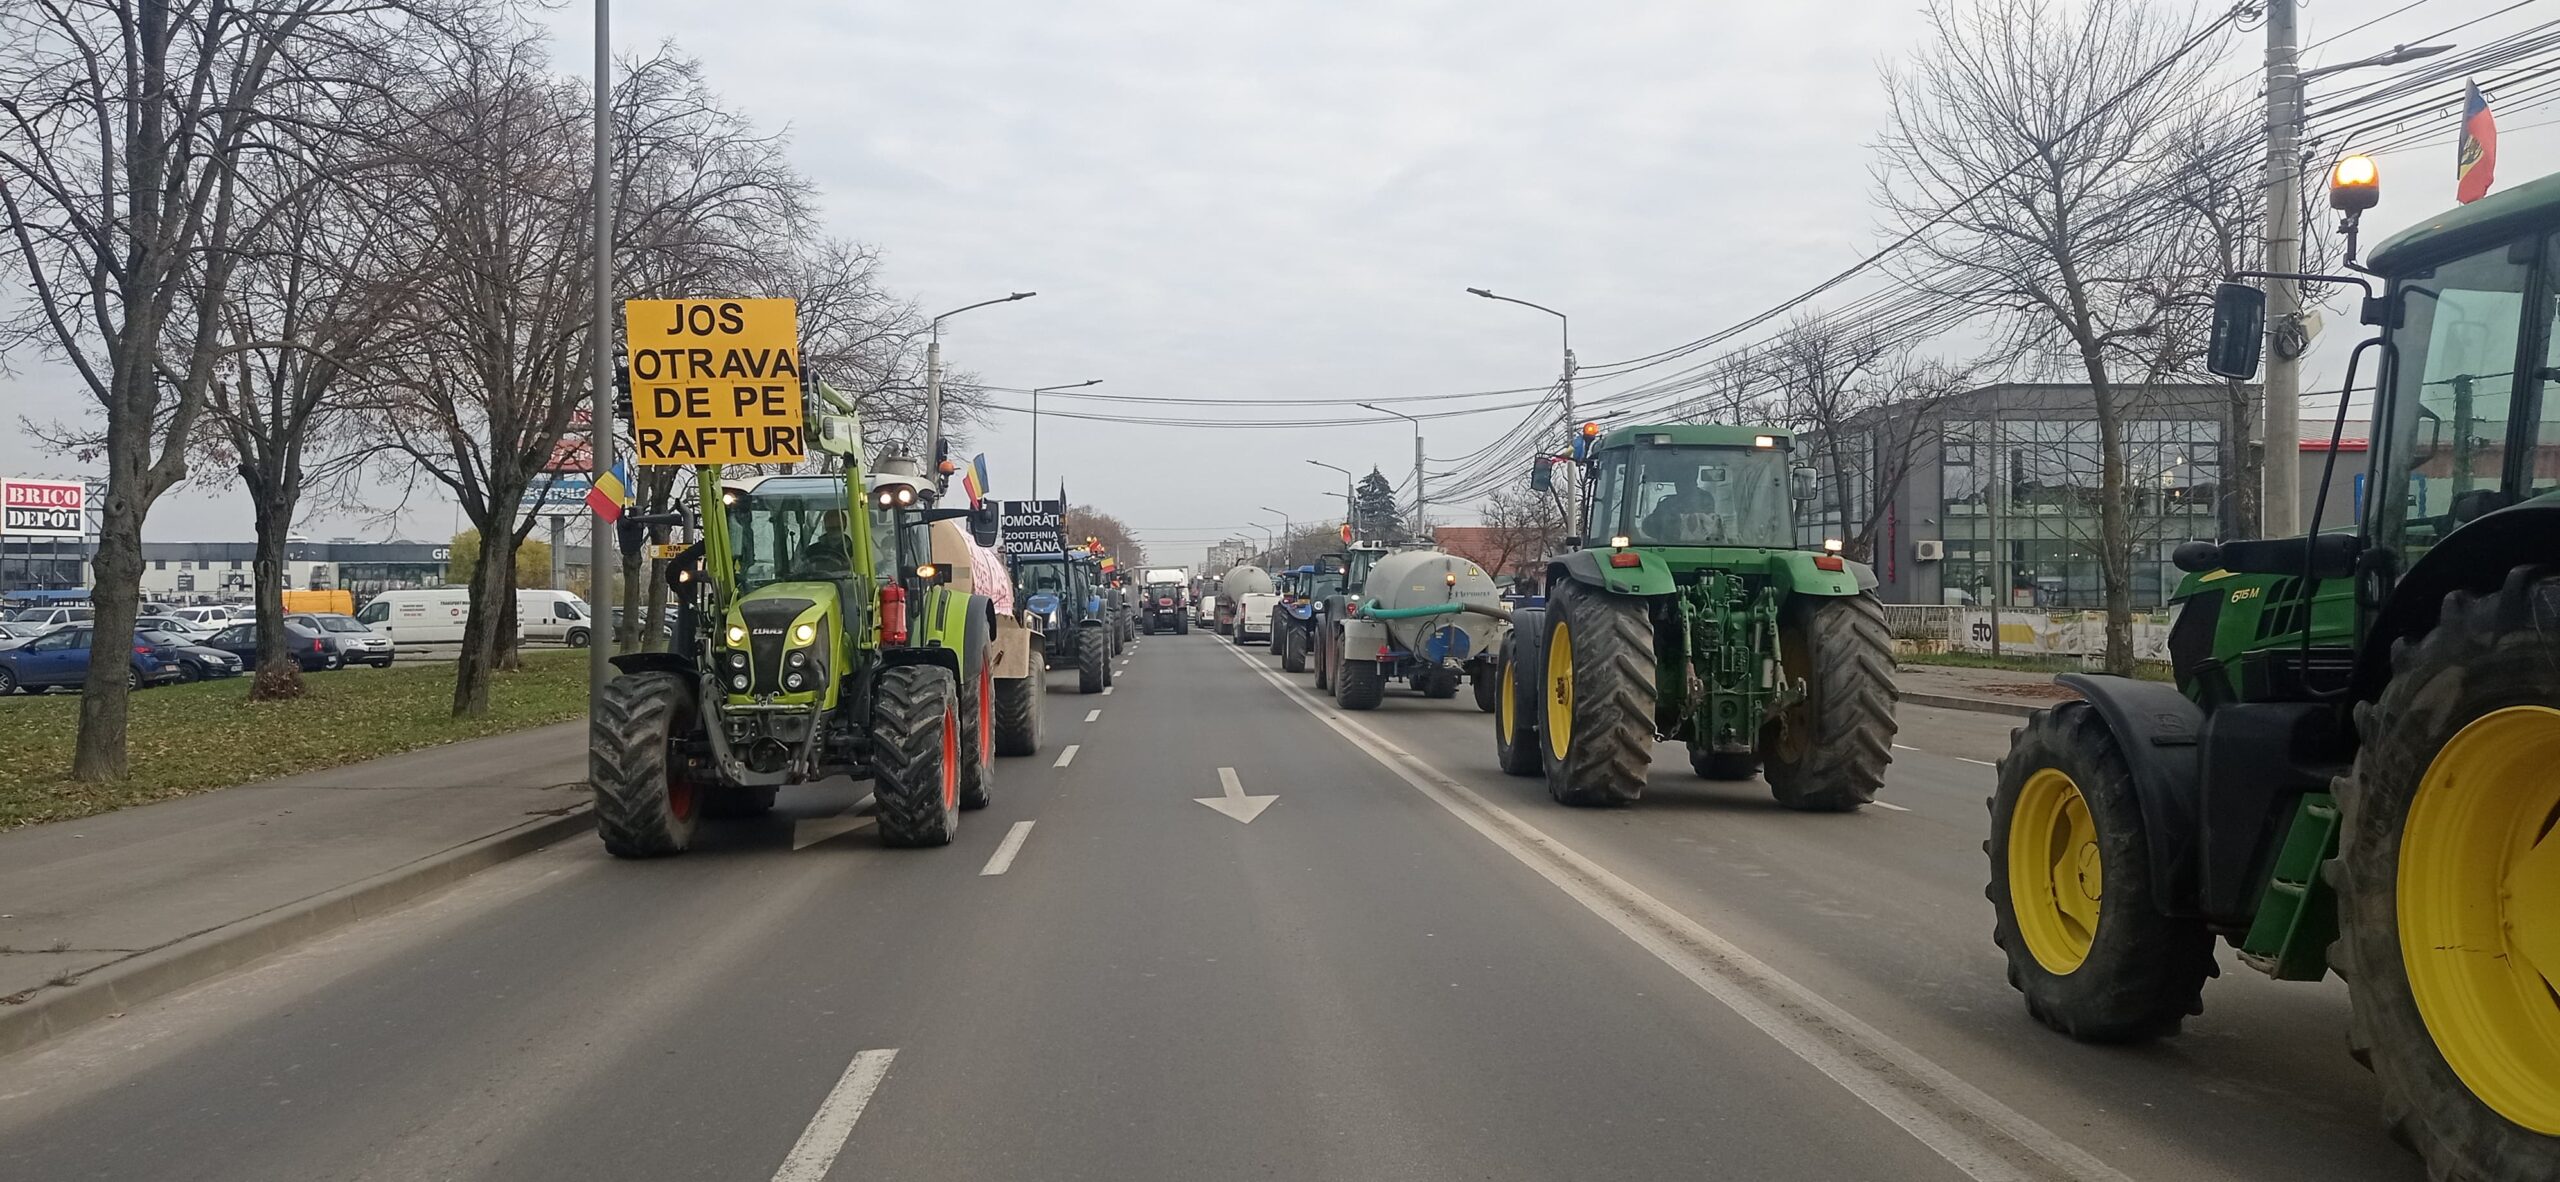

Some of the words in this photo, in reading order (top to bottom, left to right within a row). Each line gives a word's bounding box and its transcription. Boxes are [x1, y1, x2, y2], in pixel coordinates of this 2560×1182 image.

[667, 303, 744, 336] JOS
[634, 348, 798, 380] OTRAVA
[654, 387, 711, 418] DE
[733, 386, 786, 417] PE
[638, 426, 804, 459] RAFTURI
[8, 487, 79, 505] BRICO
[1021, 501, 1043, 514] NU
[8, 505, 79, 527] DEPÔT
[1005, 531, 1058, 540] ZOOTEHNIA
[1006, 539, 1062, 553] ROMÂNĂ
[1972, 617, 1992, 641] sto
